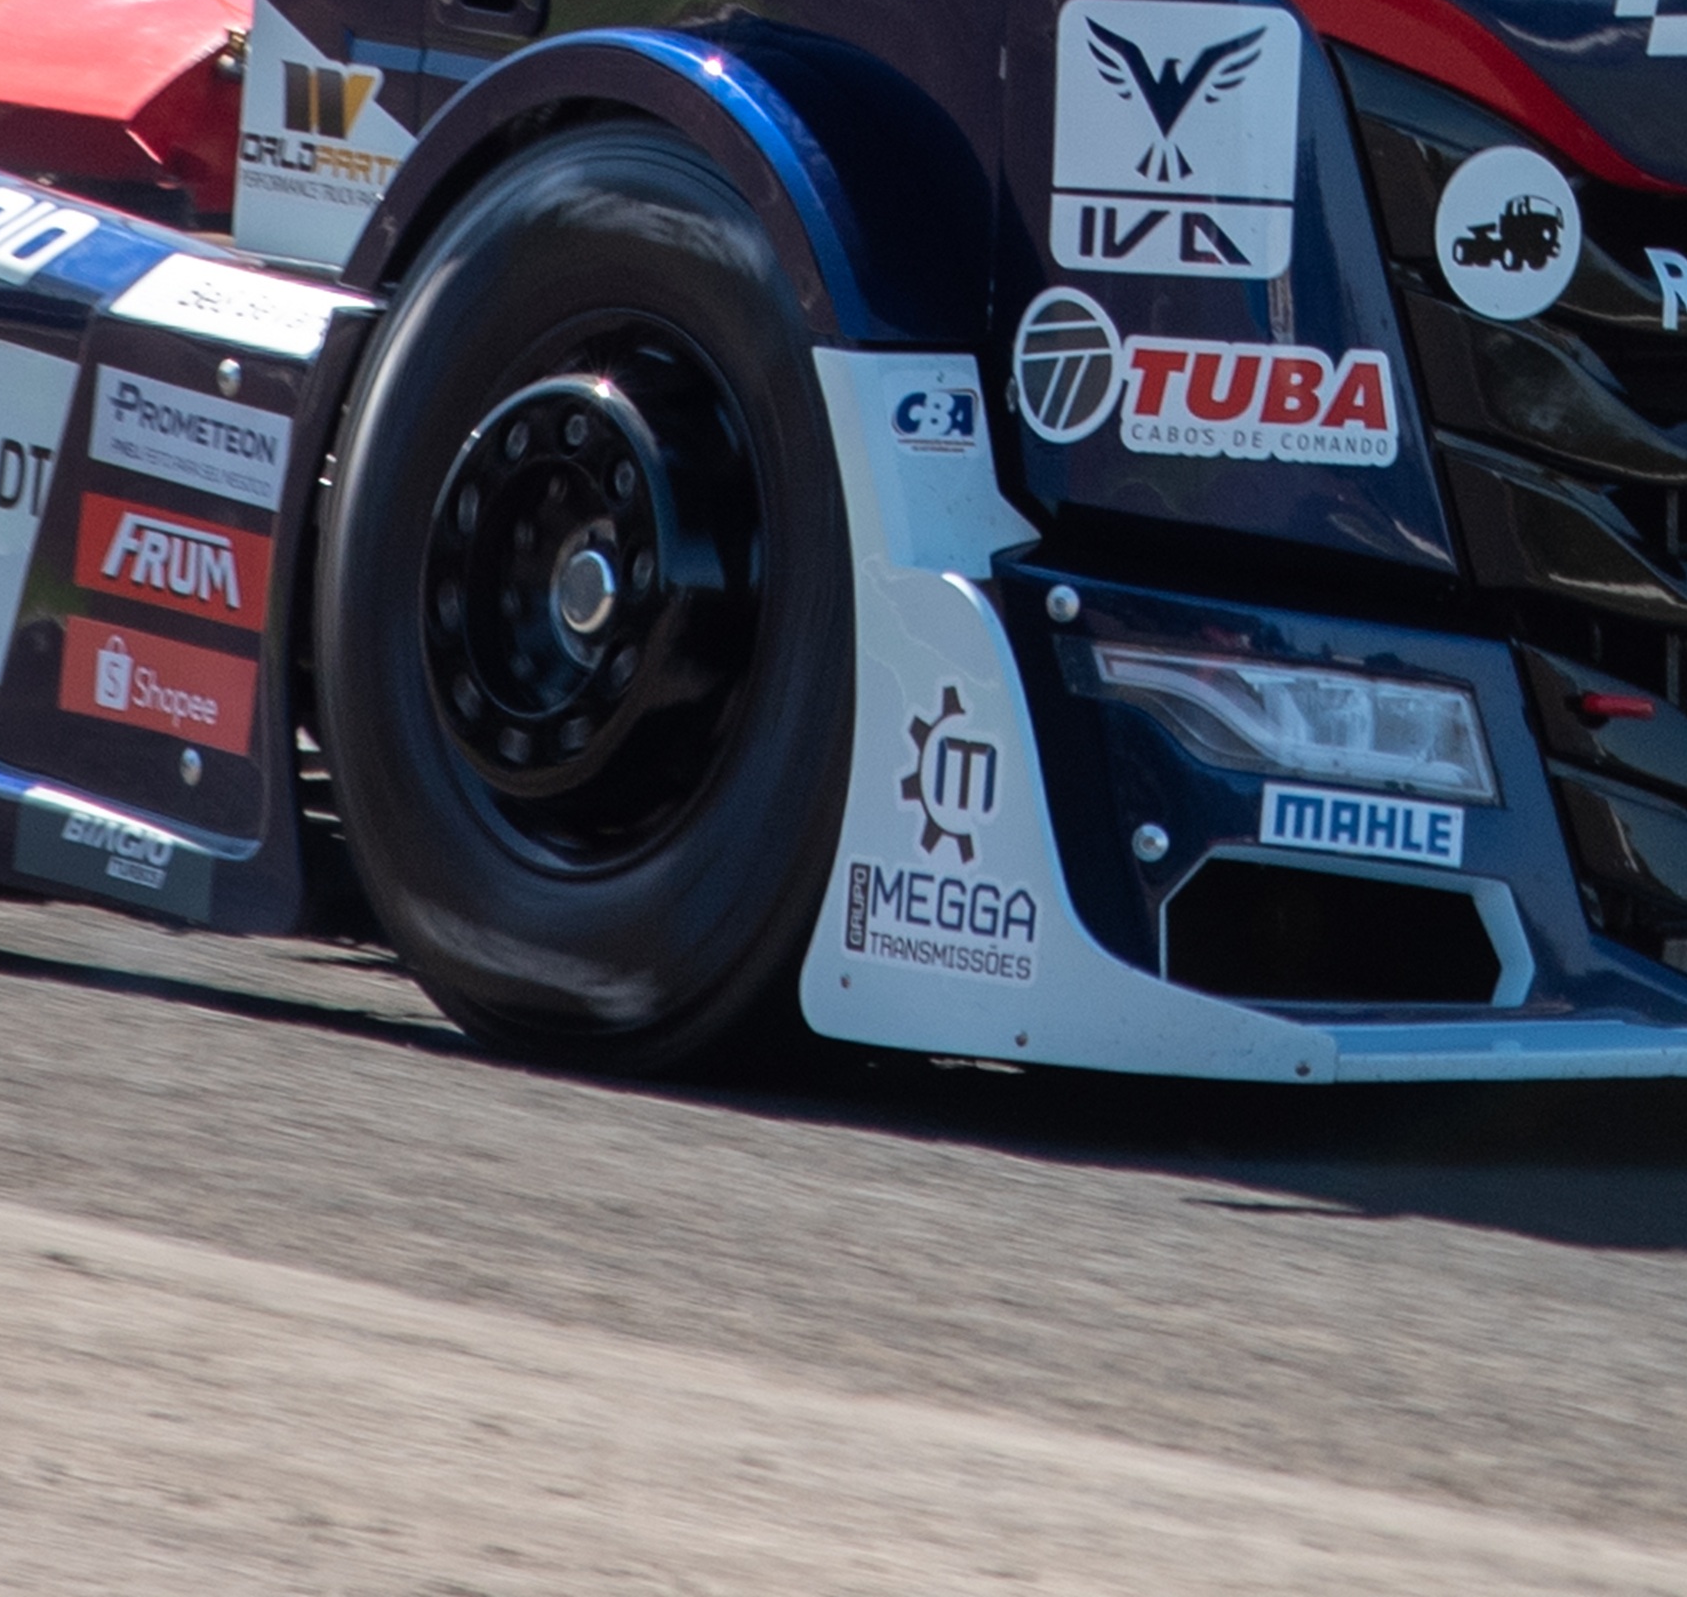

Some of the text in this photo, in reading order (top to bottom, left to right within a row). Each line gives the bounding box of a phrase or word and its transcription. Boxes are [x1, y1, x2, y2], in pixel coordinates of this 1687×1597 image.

[108, 380, 280, 466] PROMETEON
[895, 391, 974, 438] CBA
[1129, 346, 1389, 432] TUBA
[1131, 422, 1390, 457] CABOS DE COMANDO
[101, 511, 241, 609] FRUM
[131, 665, 219, 728] Shopee
[1273, 791, 1454, 858] MAHLE
[848, 865, 869, 947] GRUPO
[871, 864, 1037, 944] MEGGA
[869, 930, 1033, 982] TRANSMISSÕES
